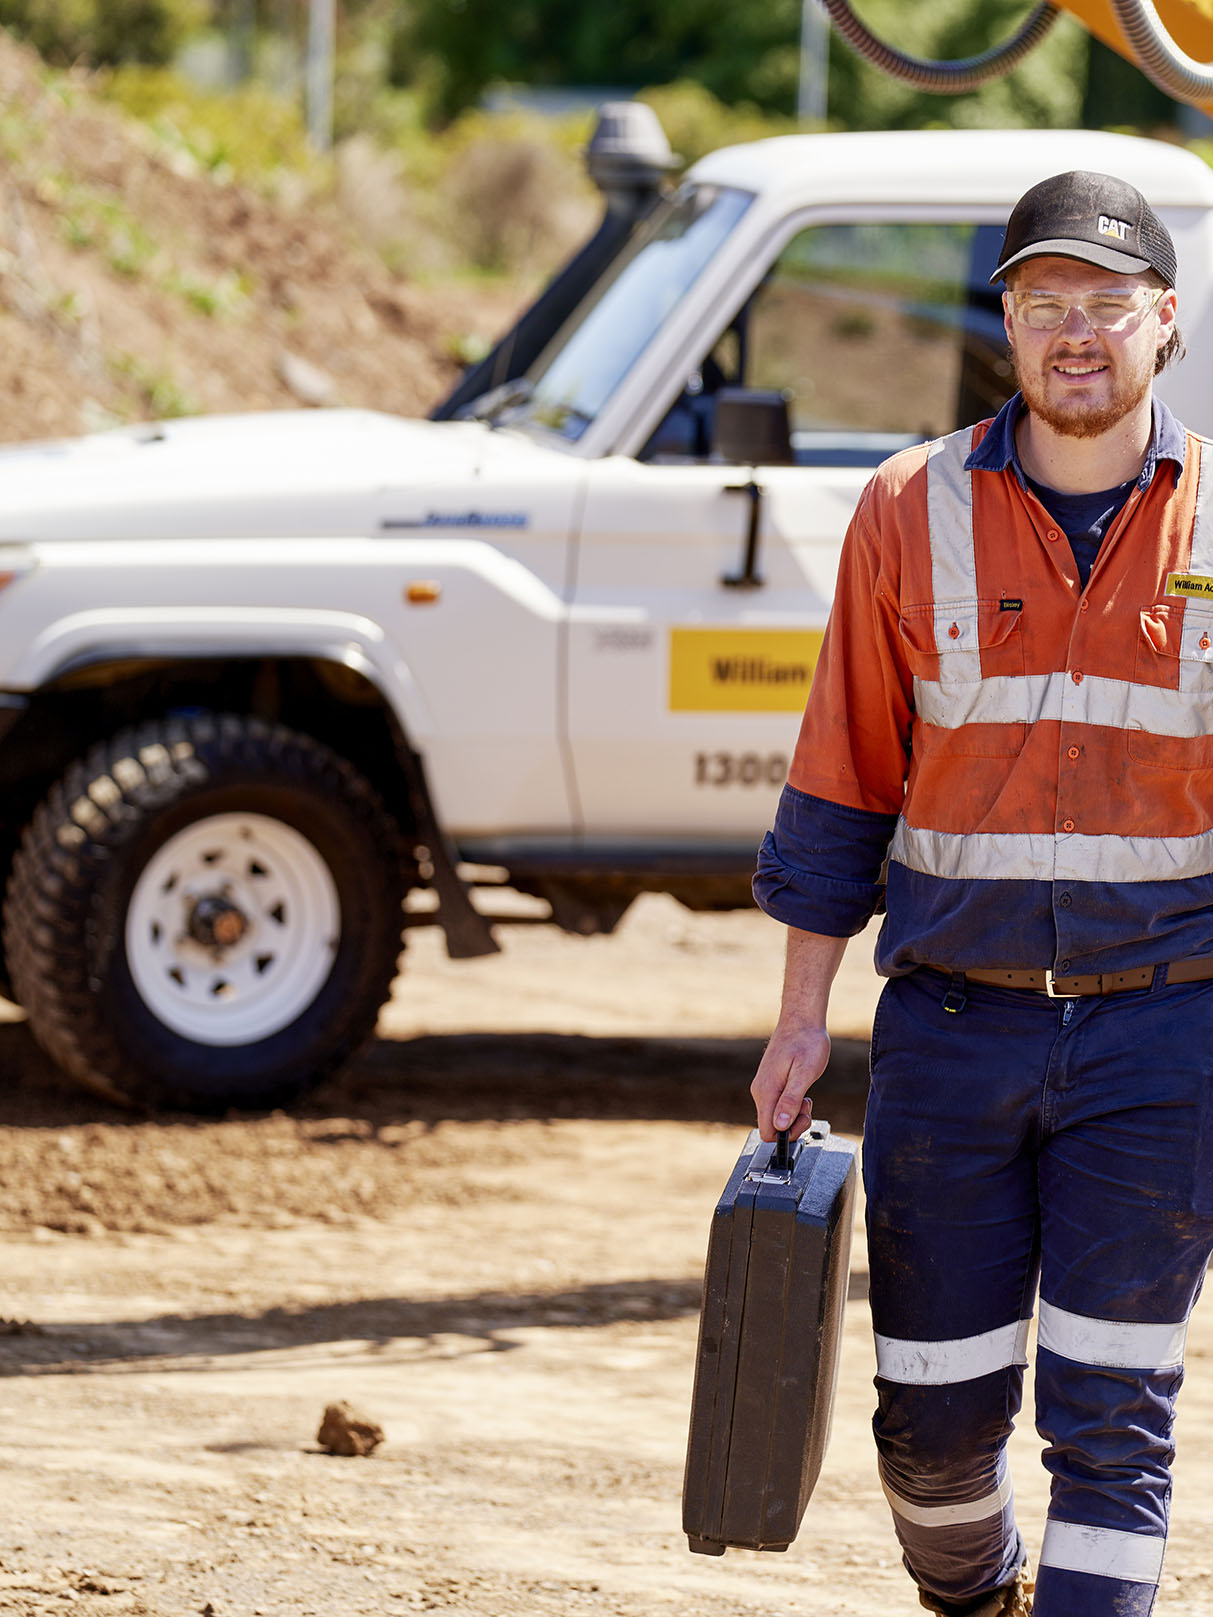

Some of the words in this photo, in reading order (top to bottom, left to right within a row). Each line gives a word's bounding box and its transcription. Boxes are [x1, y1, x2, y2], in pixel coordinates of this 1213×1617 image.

[1098, 215, 1132, 240] CAT
[1174, 580, 1203, 591] William
[712, 655, 809, 685] William
[694, 752, 789, 787] 1300
